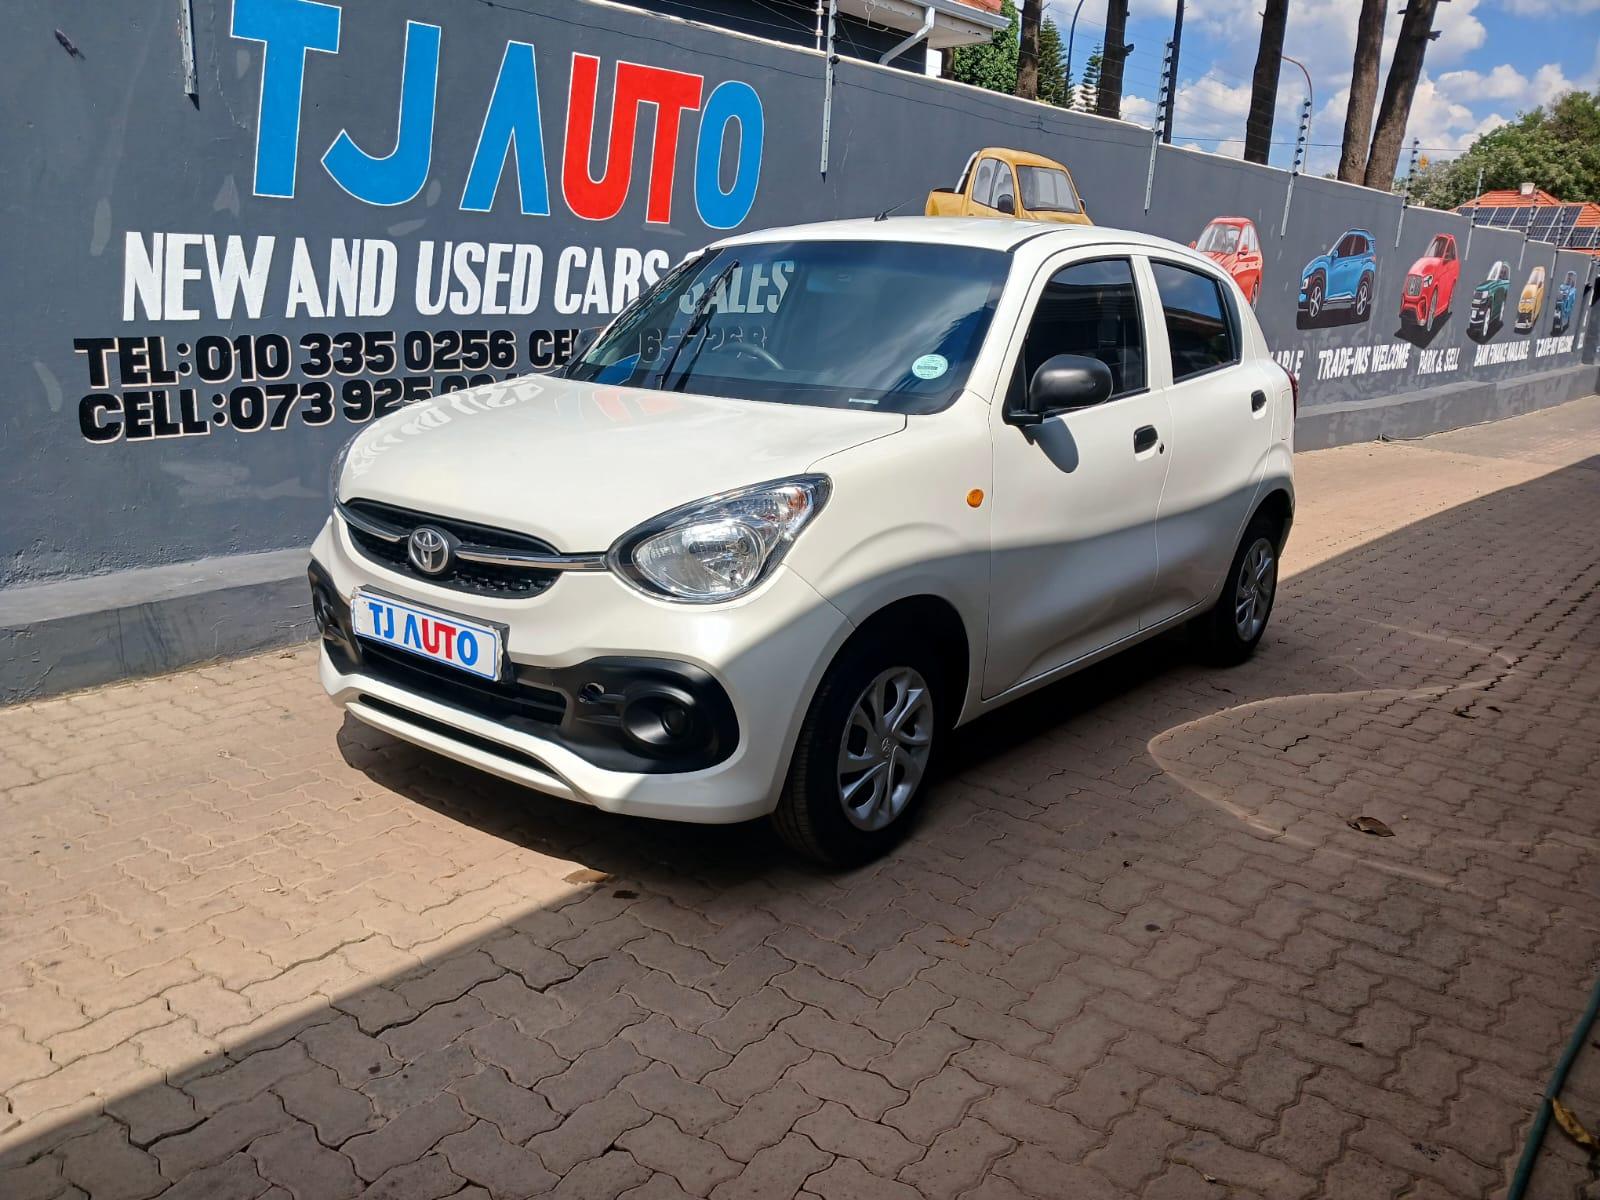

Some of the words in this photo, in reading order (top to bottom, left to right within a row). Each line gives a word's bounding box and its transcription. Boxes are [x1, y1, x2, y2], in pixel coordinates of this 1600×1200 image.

[229, 0, 442, 206] TJ
[459, 41, 765, 230] AUTO
[123, 231, 276, 321] NEW
[285, 237, 398, 318] AND
[415, 240, 543, 315] USED
[554, 246, 669, 314] CARS
[300, 331, 396, 377] 335
[404, 329, 517, 373] 0256
[1317, 346, 1371, 380] TRADE-INS
[1371, 342, 1412, 373] WELCOME
[1417, 349, 1439, 375] PARK
[1443, 348, 1461, 372] SELL
[342, 376, 433, 423] 925
[368, 602, 395, 640] TJ
[403, 613, 479, 666] AUTO
